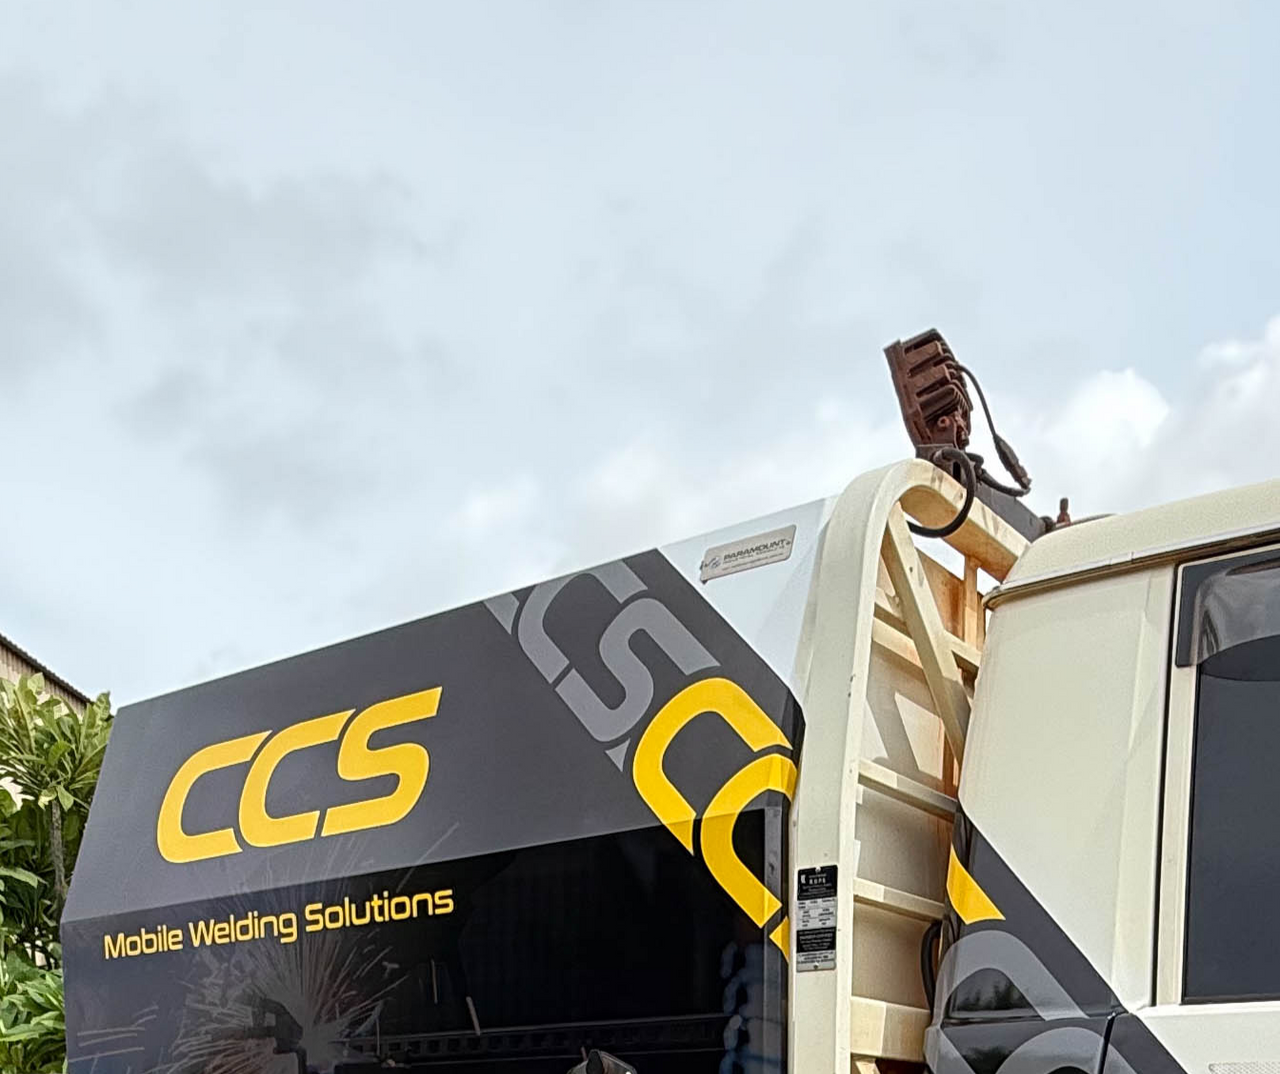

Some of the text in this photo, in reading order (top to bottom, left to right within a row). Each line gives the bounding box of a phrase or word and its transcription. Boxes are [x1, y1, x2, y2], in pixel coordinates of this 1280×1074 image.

[723, 539, 786, 561] PARAMOUNT
[156, 686, 443, 864] CCS
[103, 888, 455, 959] Mobile Welding Solutions
